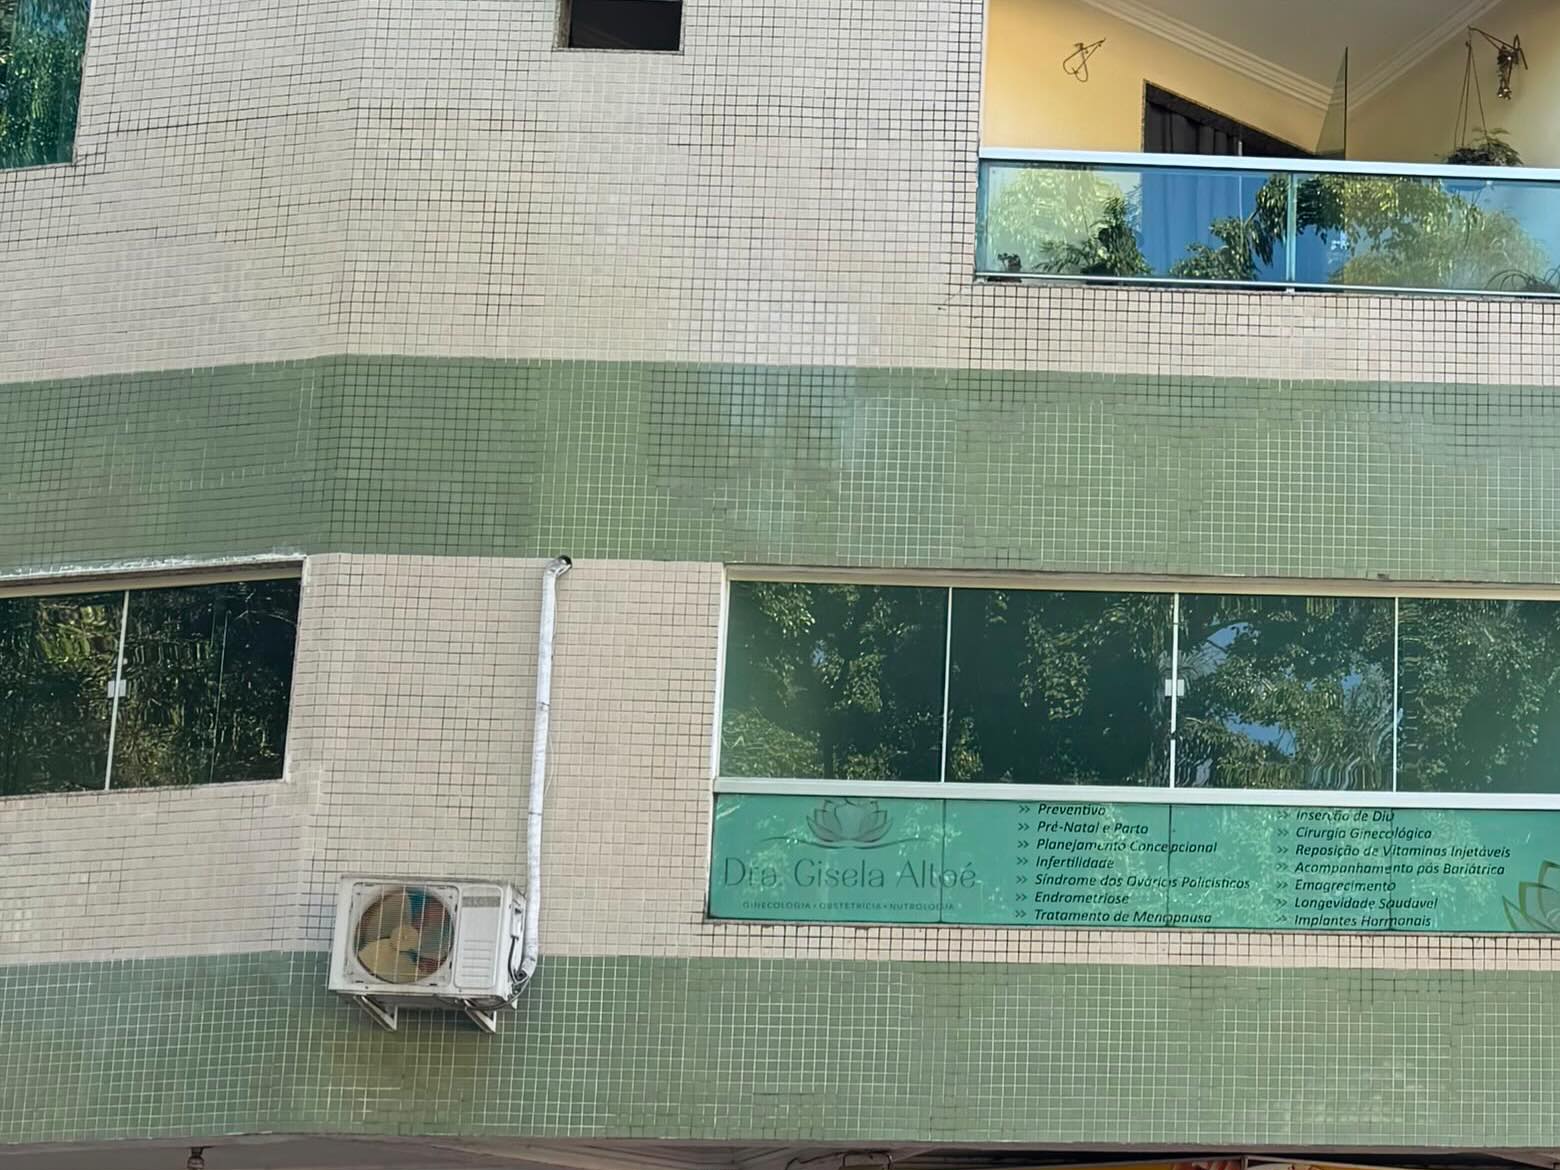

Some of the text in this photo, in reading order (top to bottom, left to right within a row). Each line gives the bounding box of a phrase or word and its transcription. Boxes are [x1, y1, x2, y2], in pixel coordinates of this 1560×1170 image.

[1037, 803, 1106, 817] Preventivo
[1353, 810, 1368, 822] de
[1372, 810, 1394, 822] Diu
[1037, 821, 1149, 835] Pré-Natal e Parto
[1296, 827, 1432, 841] Cirurgia Ginecológica
[1295, 844, 1360, 858] Reposição
[1363, 845, 1379, 856] de
[1383, 845, 1447, 858] Vitaminas
[1035, 855, 1115, 870] Infertilidade
[724, 857, 977, 889] Dra. Gisela Altoé
[1294, 862, 1505, 878] Acompanhamento pós Bariátrica
[1034, 873, 1096, 887] Síndrome
[1100, 874, 1123, 887] dos
[1294, 879, 1396, 895] Emagrecimento
[1034, 891, 1129, 906] Endrometriose
[1294, 897, 1375, 911] Longevidade
[1034, 909, 1212, 926] Tratamento de Menopausa
[1294, 915, 1431, 929] Implantes Hormonais
